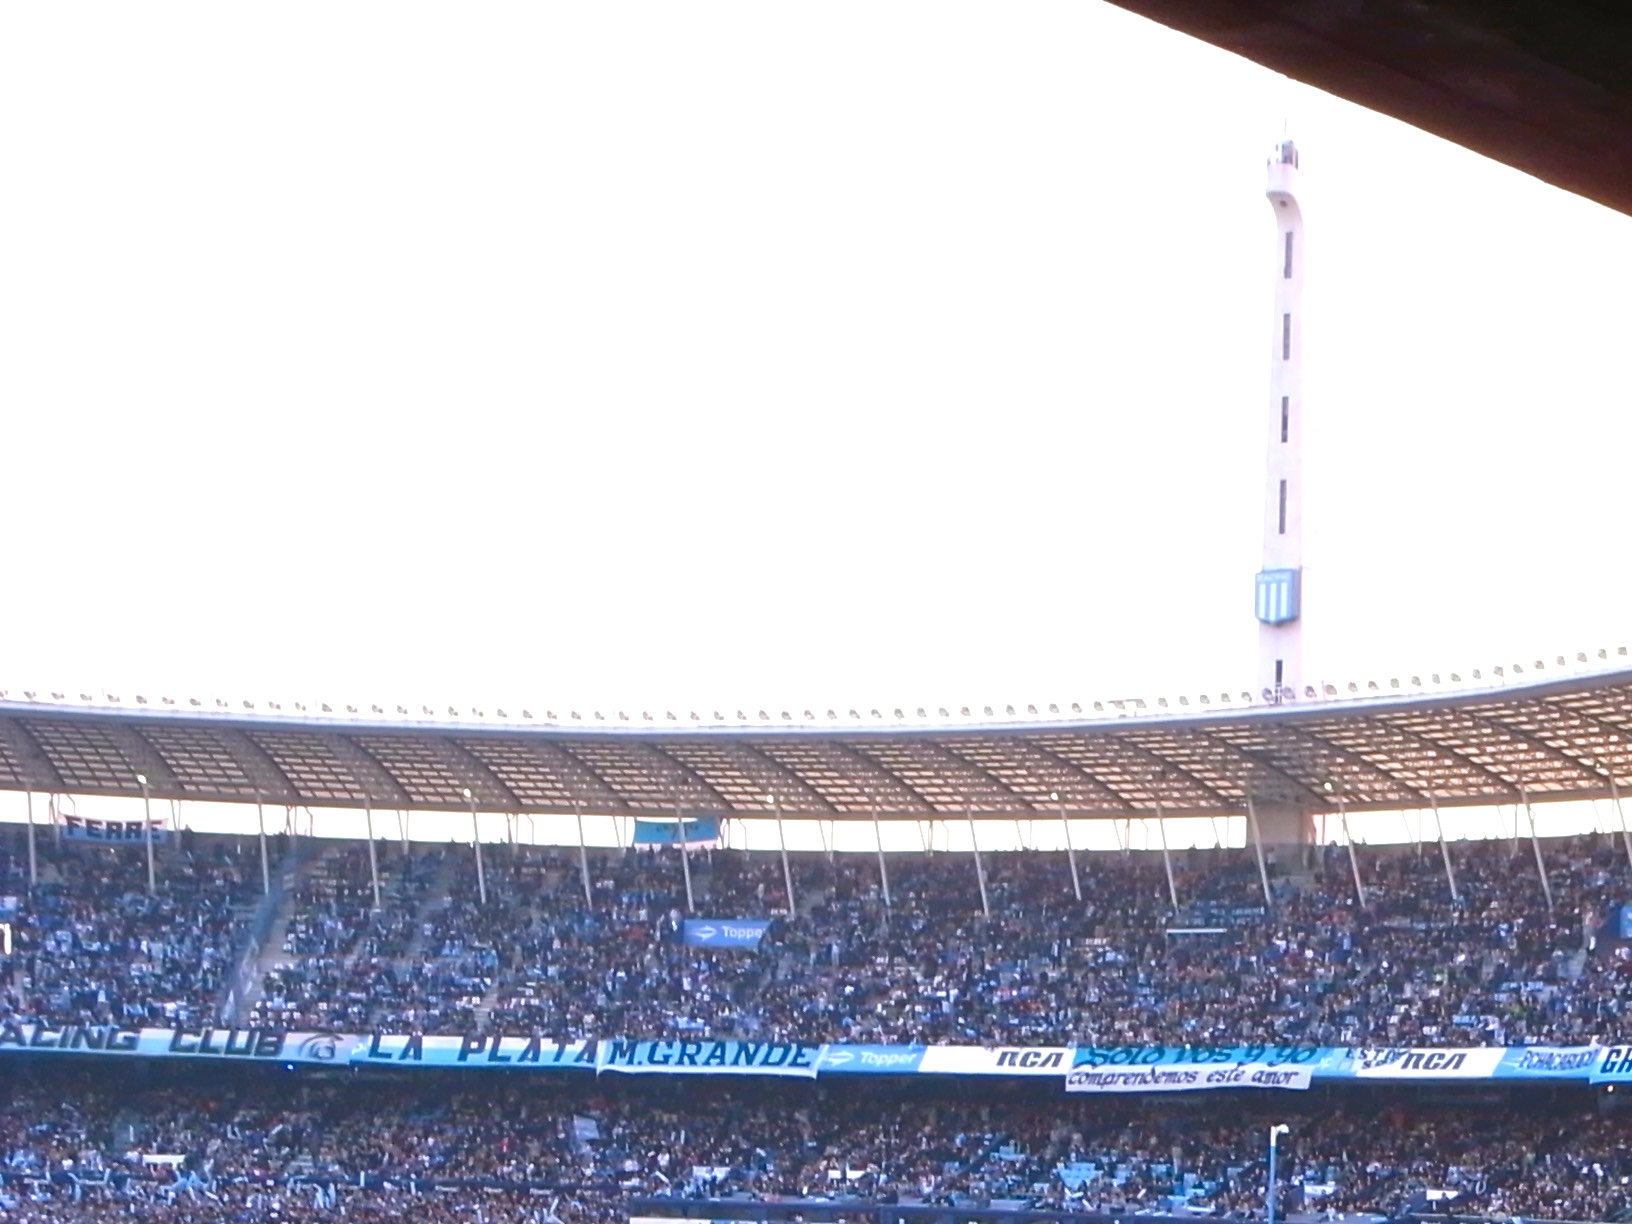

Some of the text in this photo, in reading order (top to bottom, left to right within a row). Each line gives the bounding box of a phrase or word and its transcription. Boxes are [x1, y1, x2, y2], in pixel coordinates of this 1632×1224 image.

[64, 814, 164, 840] FERRE
[168, 1024, 286, 1058] CLUB
[368, 1033, 599, 1064] LA PLATA
[860, 1049, 918, 1066] Topper
[995, 1051, 1065, 1069] RCA
[1399, 1051, 1468, 1071] RCA
[1067, 1066, 1300, 1089] comprendemos este amor
